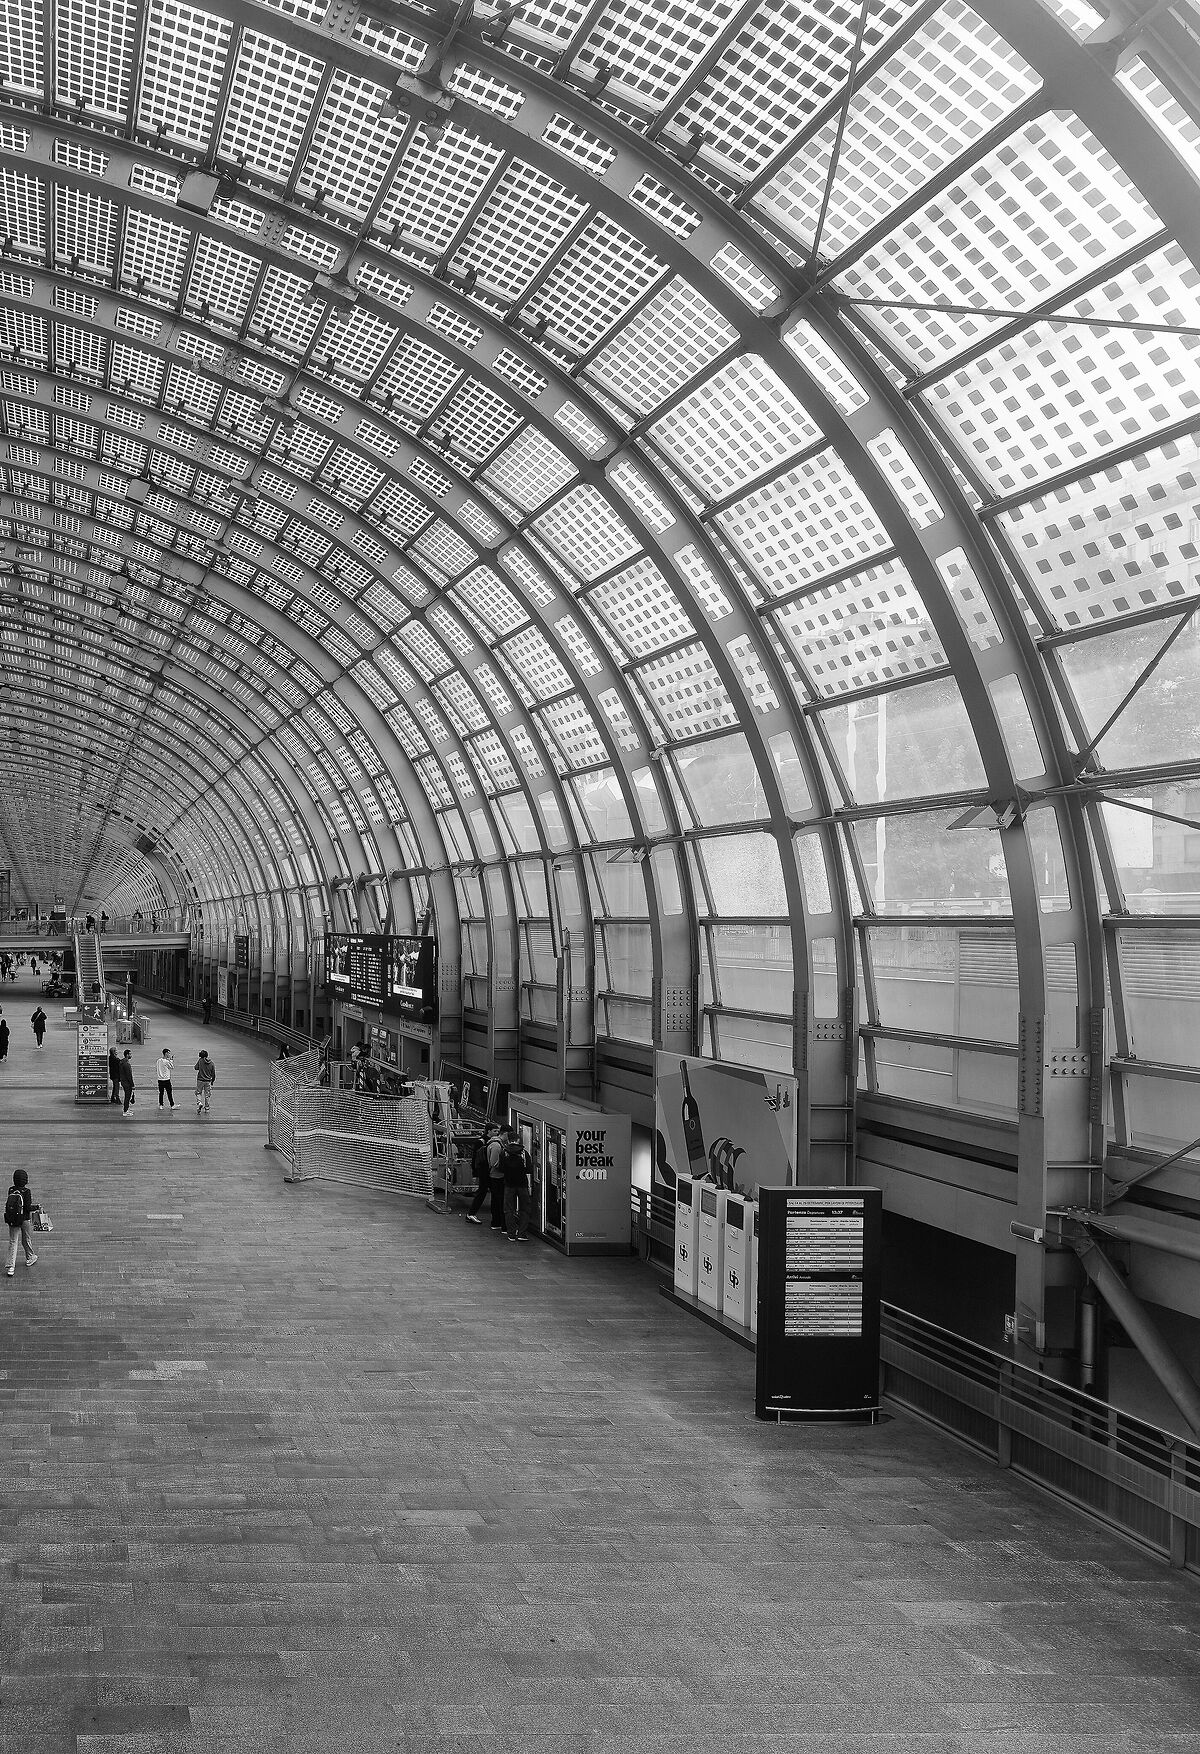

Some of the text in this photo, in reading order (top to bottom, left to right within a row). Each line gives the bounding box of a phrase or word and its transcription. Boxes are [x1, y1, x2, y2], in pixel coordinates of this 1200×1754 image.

[576, 1130, 606, 1142] your
[576, 1141, 605, 1154] best
[576, 1155, 614, 1167] break
[576, 1168, 608, 1180] .com
